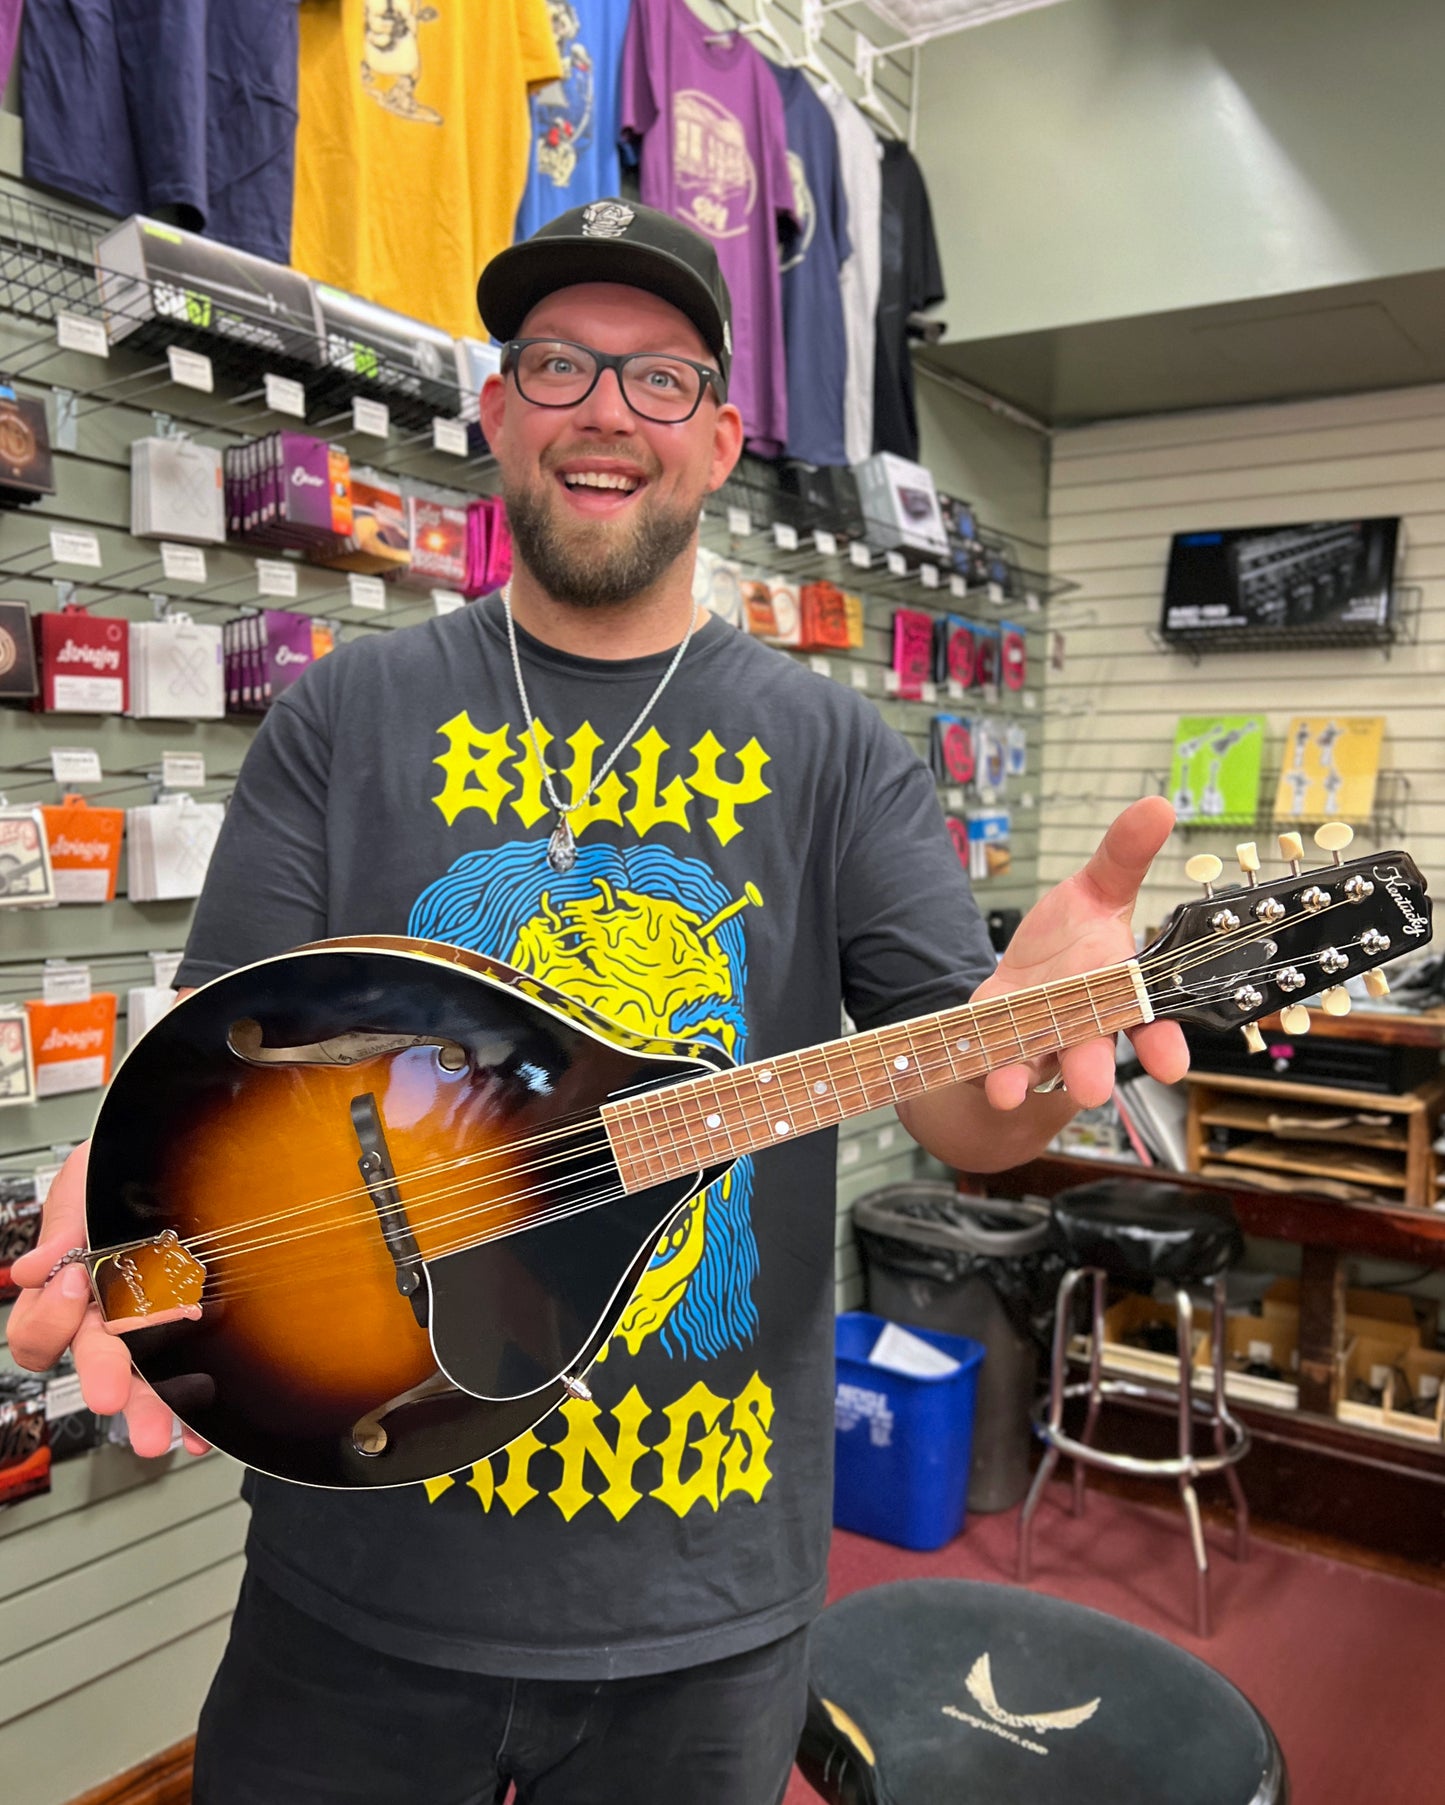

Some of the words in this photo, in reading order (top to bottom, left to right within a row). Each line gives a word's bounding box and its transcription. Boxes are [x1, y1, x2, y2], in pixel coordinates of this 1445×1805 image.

[431, 709, 773, 848] BILLY
[1372, 866, 1429, 938] Kentucky
[424, 1370, 775, 1522] INGS
